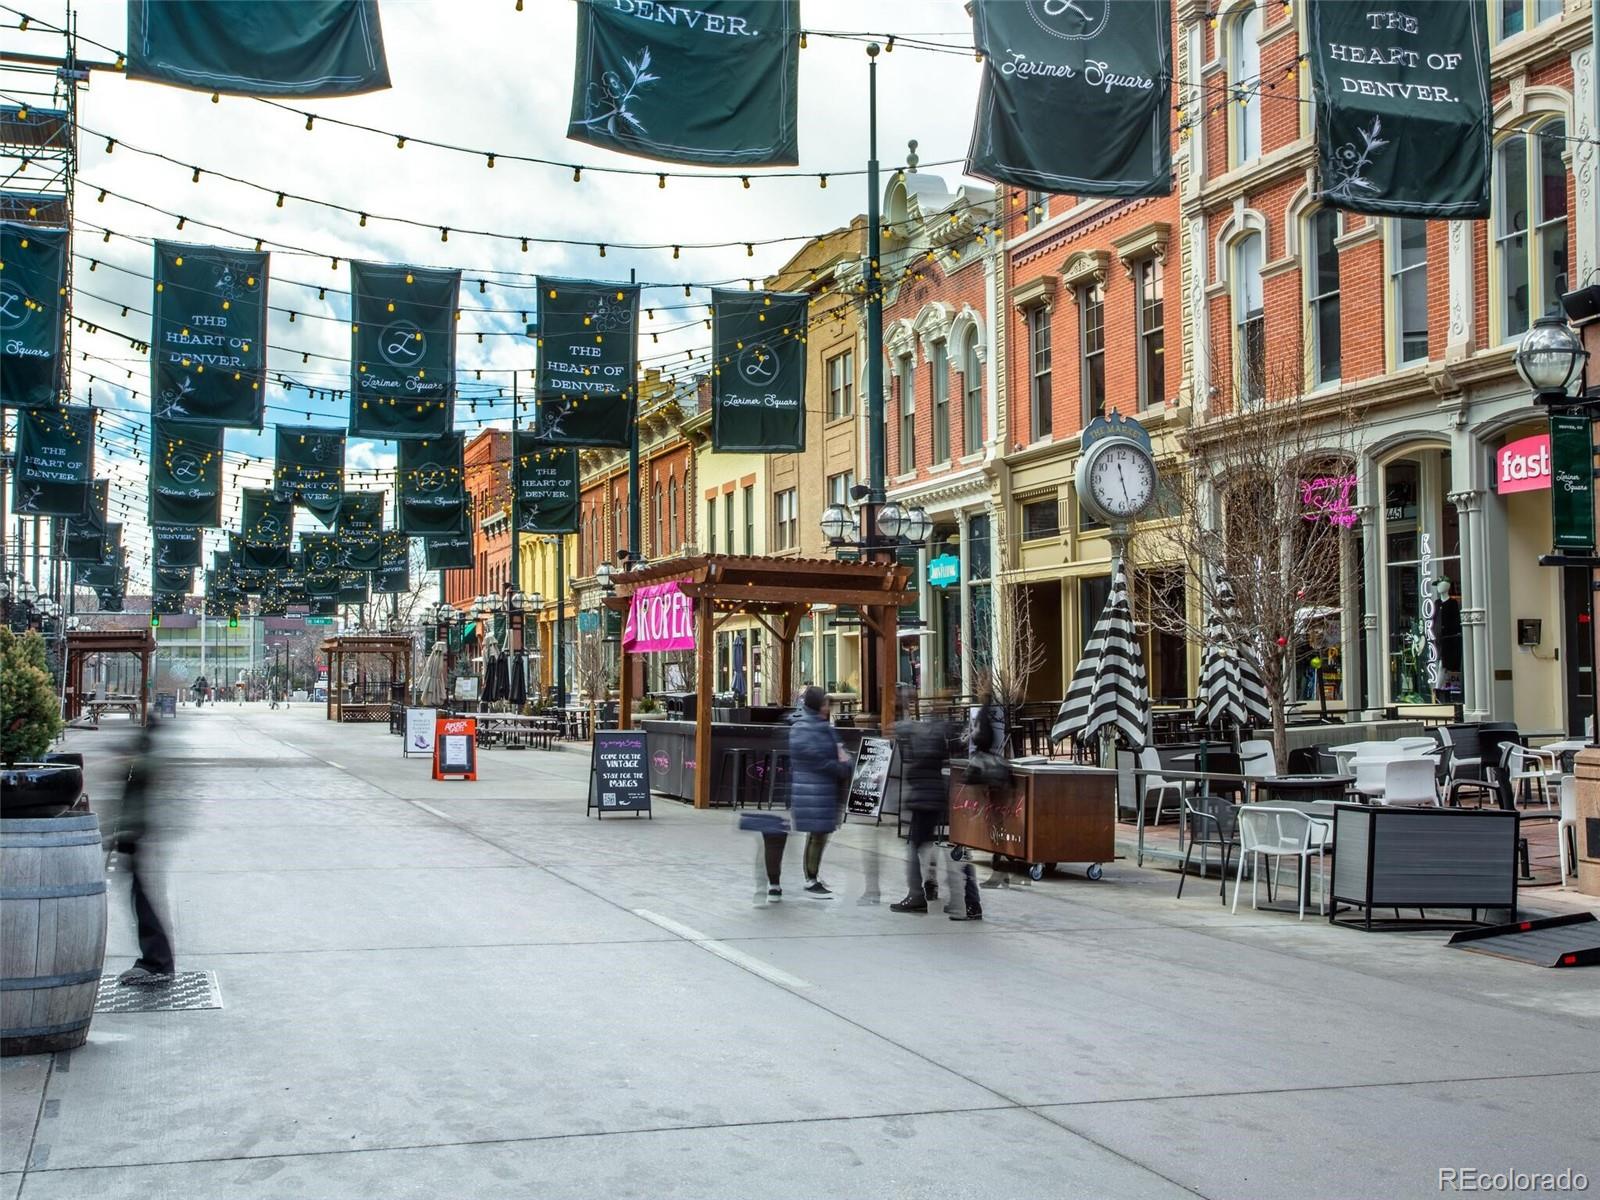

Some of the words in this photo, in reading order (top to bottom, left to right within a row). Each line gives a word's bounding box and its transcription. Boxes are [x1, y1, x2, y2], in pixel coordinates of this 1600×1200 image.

[614, 0, 759, 36] DENVER.
[1366, 12, 1418, 34] THE
[1329, 43, 1420, 68] HEART
[1426, 53, 1463, 70] OF
[1001, 48, 1075, 80] Larimer
[1084, 59, 1154, 94] Square
[1340, 76, 1459, 102] DENVER.
[191, 315, 227, 328] THE
[166, 332, 226, 346] HEART
[6, 339, 50, 358] Square
[569, 345, 602, 357] THE
[604, 366, 625, 376] OF
[361, 373, 401, 389] Larimer
[405, 375, 443, 392] Square
[551, 379, 620, 392] DENVER.
[723, 393, 761, 407] Larimer
[764, 393, 798, 409] Square
[41, 446, 66, 456] THE
[1117, 451, 1126, 460] 12
[24, 456, 65, 468] HEART
[1107, 454, 1113, 462] 11
[1131, 455, 1136, 464] 1
[1502, 445, 1551, 482] fast
[1138, 464, 1144, 473] 2
[1141, 477, 1148, 486] 3
[1099, 488, 1105, 496] 8
[1137, 491, 1144, 499] 4
[1107, 498, 1113, 507] 7
[1118, 501, 1125, 510] 6
[1421, 533, 1438, 684] RECORDS
[651, 592, 693, 640] OPEN
[606, 760, 639, 768] VINTAGE
